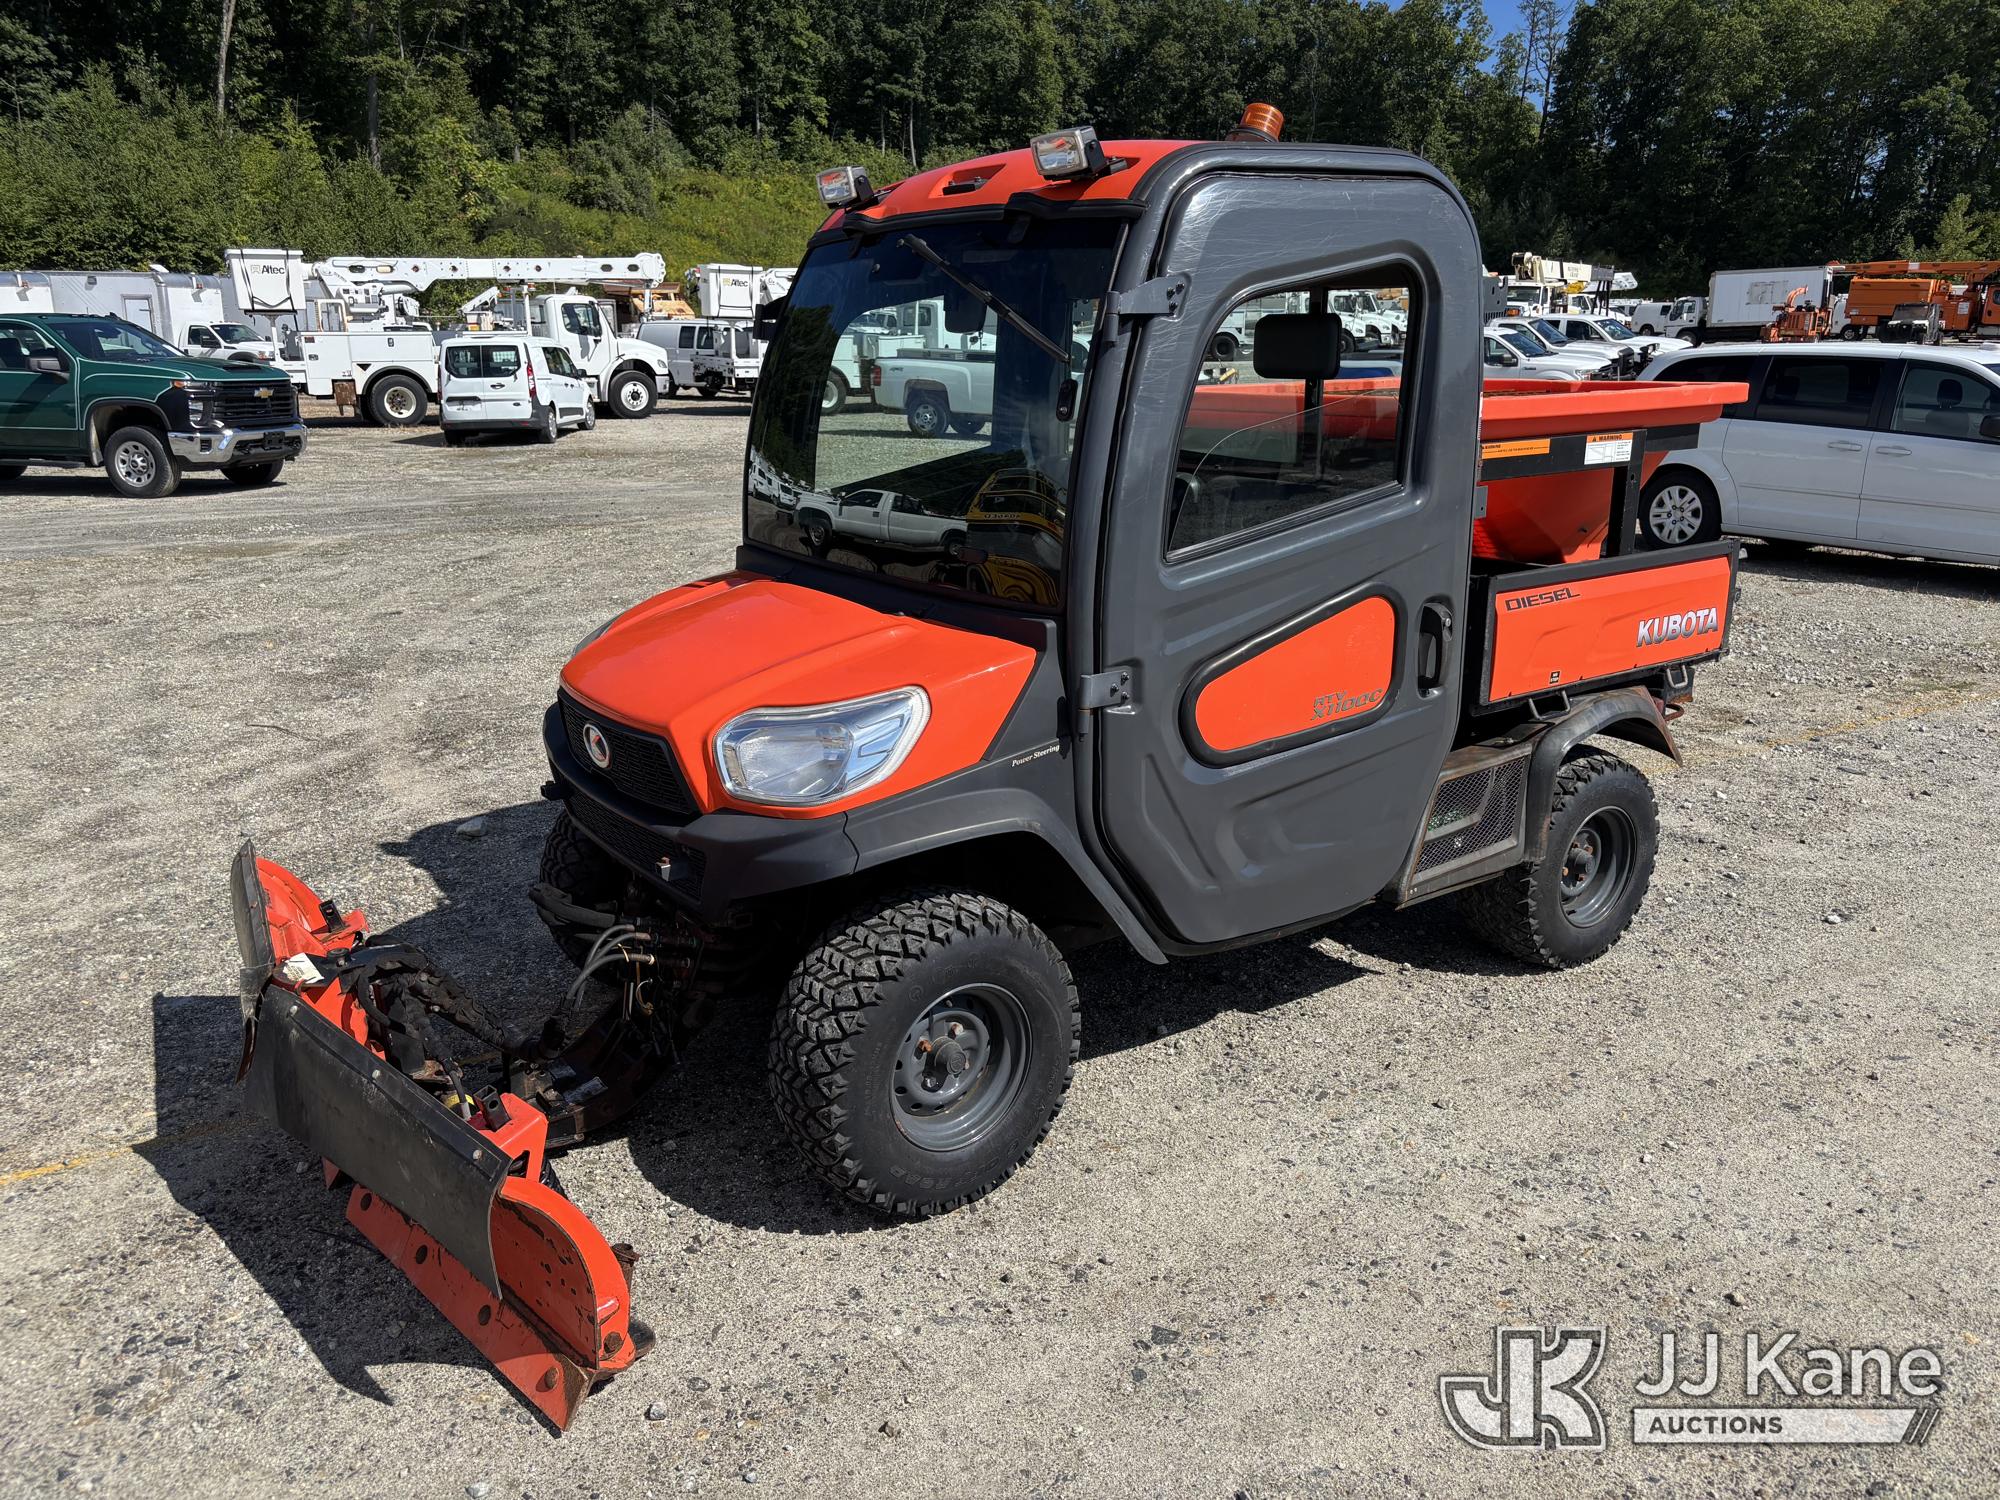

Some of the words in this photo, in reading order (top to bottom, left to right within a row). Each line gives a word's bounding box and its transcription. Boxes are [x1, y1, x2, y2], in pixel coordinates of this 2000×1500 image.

[262, 265, 285, 274] Altec
[1505, 587, 1581, 611] DIESEL
[1636, 607, 1718, 648] KUBOTA
[1313, 690, 1348, 708] RTV
[1012, 755, 1033, 767] Power
[1033, 745, 1060, 759] Steering
